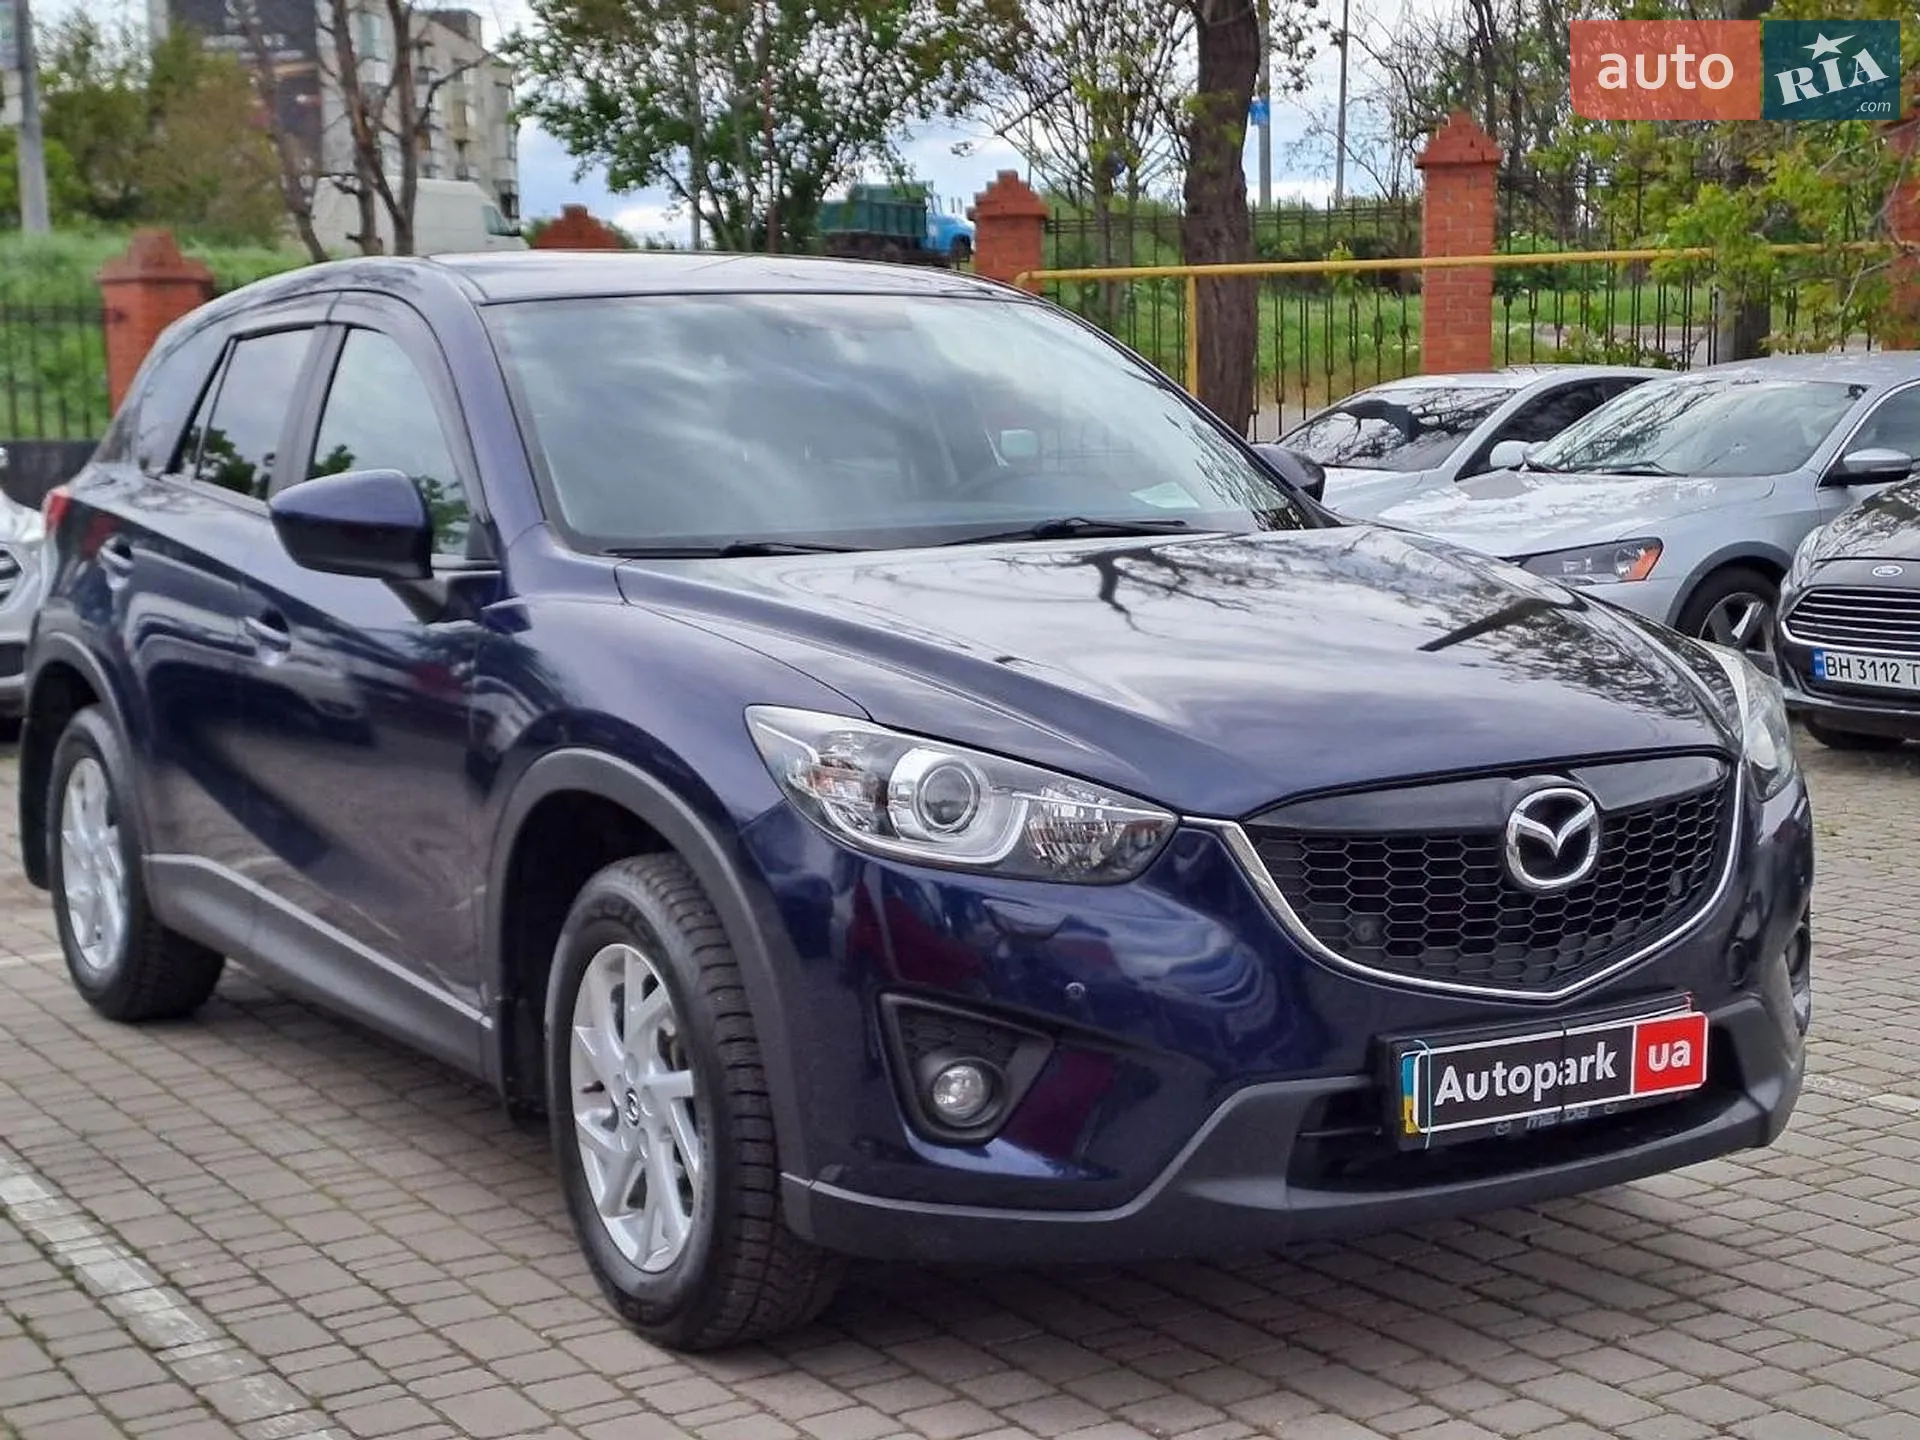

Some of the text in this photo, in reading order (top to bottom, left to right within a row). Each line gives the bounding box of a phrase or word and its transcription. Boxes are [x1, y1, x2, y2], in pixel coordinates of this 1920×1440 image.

[1826, 656, 1852, 679] BH
[1857, 659, 1901, 683] 3112
[1433, 1039, 1692, 1107] Autopark ua
